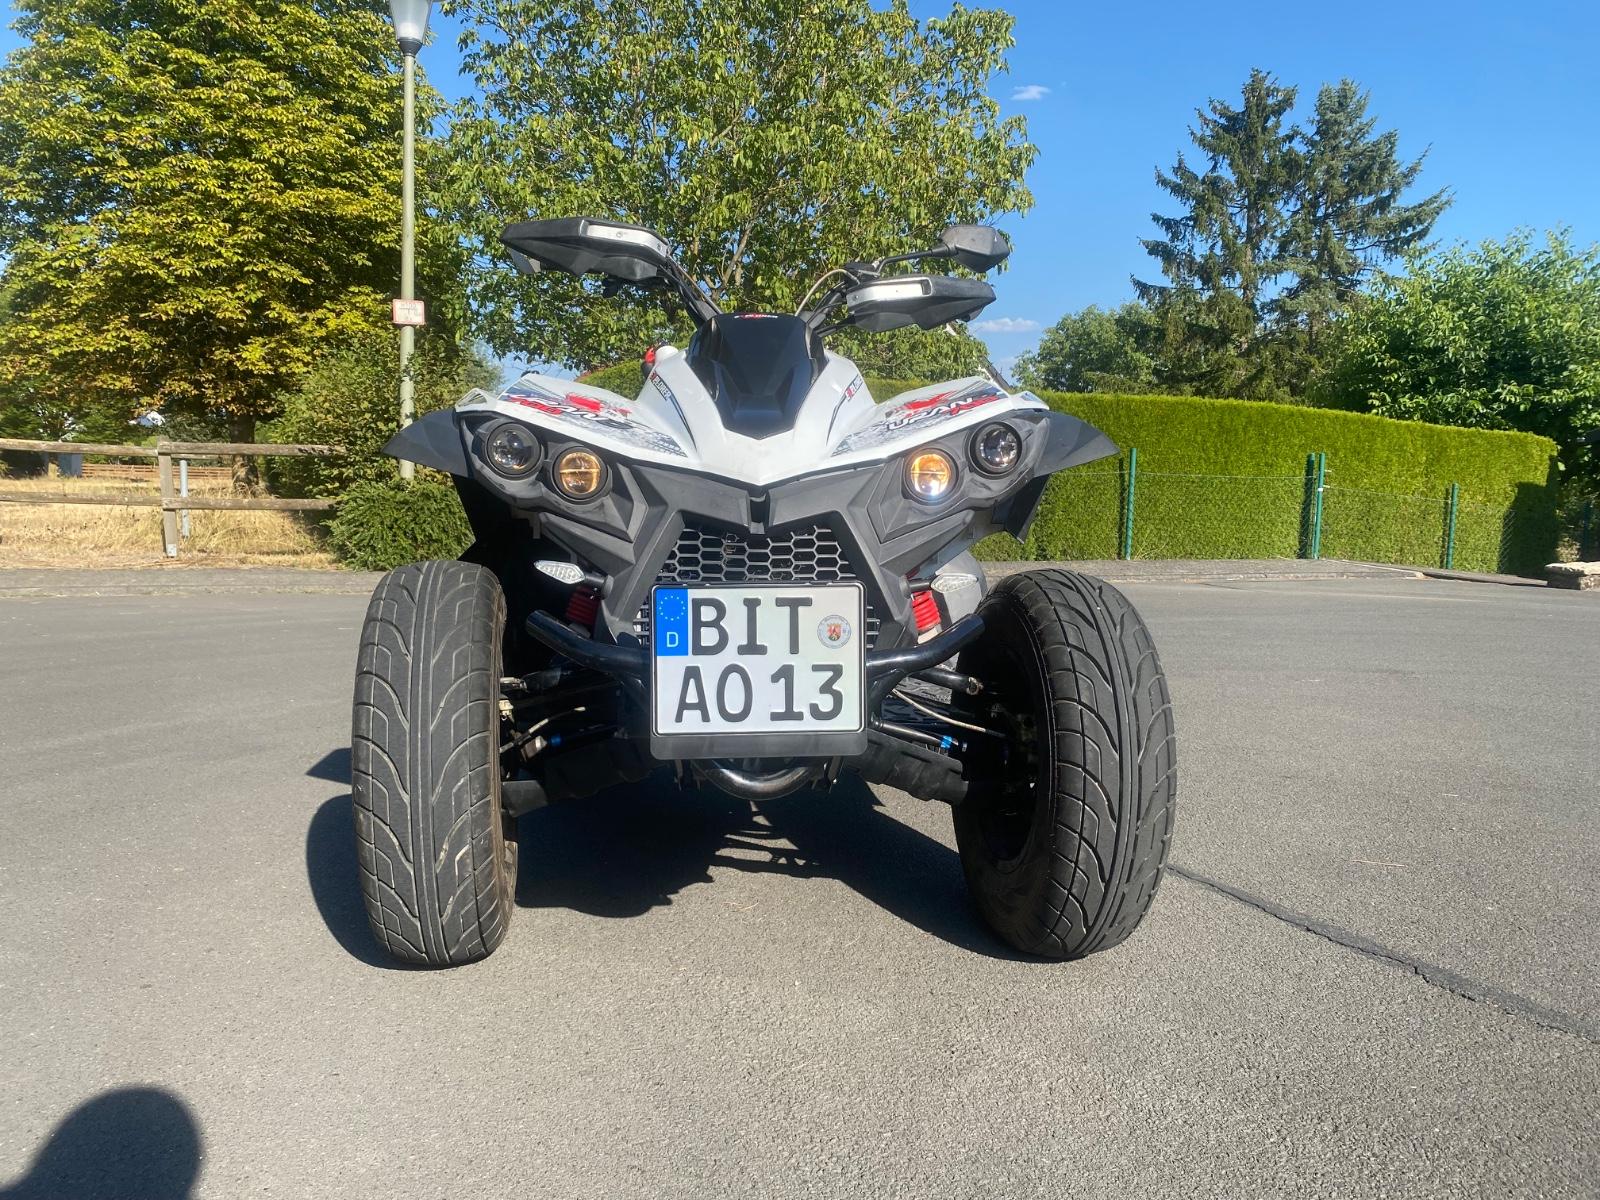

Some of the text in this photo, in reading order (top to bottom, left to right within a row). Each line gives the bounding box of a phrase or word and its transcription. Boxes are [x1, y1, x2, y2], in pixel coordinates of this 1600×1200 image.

[666, 631, 679, 648] D
[691, 597, 813, 656] BIT
[674, 663, 844, 723] AO 13
